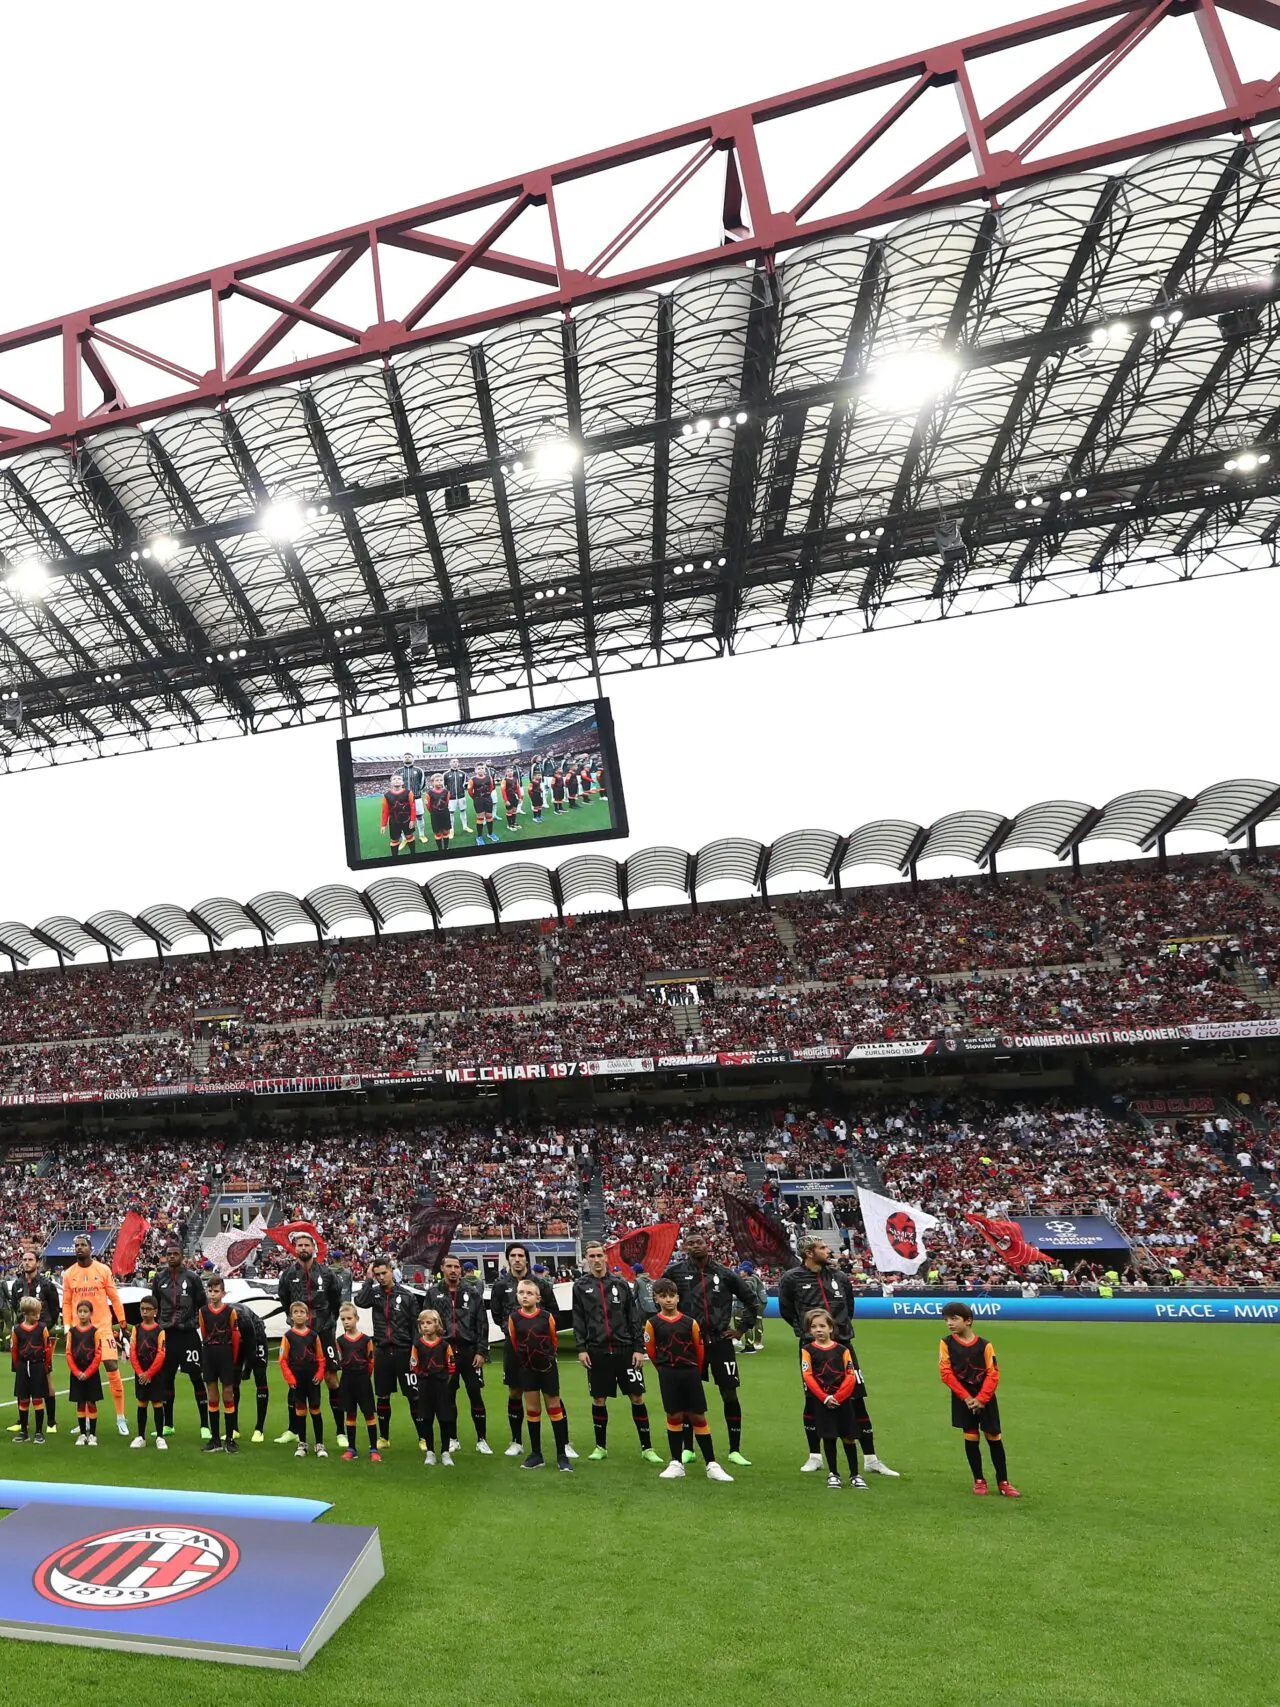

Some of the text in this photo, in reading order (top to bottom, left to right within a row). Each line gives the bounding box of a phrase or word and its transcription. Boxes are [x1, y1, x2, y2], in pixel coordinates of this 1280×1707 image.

[1195, 1020, 1277, 1030] MILAN CLUB
[1014, 1028, 1180, 1049] COMMERCIALISTI ROSSONERI
[1198, 1027, 1280, 1039] LIVIGNO (SO
[793, 1048, 840, 1057] BORDIGHERA
[965, 1042, 996, 1050] Slovakia
[740, 1055, 786, 1066] ARCORE
[255, 1076, 342, 1095] CASTELFIDARDO
[374, 1077, 422, 1085] DESENZANO
[104, 1091, 139, 1100] KOSOVO
[893, 1302, 943, 1315] PEACE
[1155, 1304, 1215, 1318] PEACE
[1234, 1305, 1279, 1318] МИР
[105, 1338, 117, 1350] 16
[186, 1350, 199, 1362] 20
[327, 1345, 335, 1358] 9
[724, 1361, 736, 1376] 17
[405, 1373, 418, 1386] 10
[627, 1368, 643, 1383] 56
[119, 1530, 211, 1548] ACM
[62, 1583, 151, 1600] 1899
